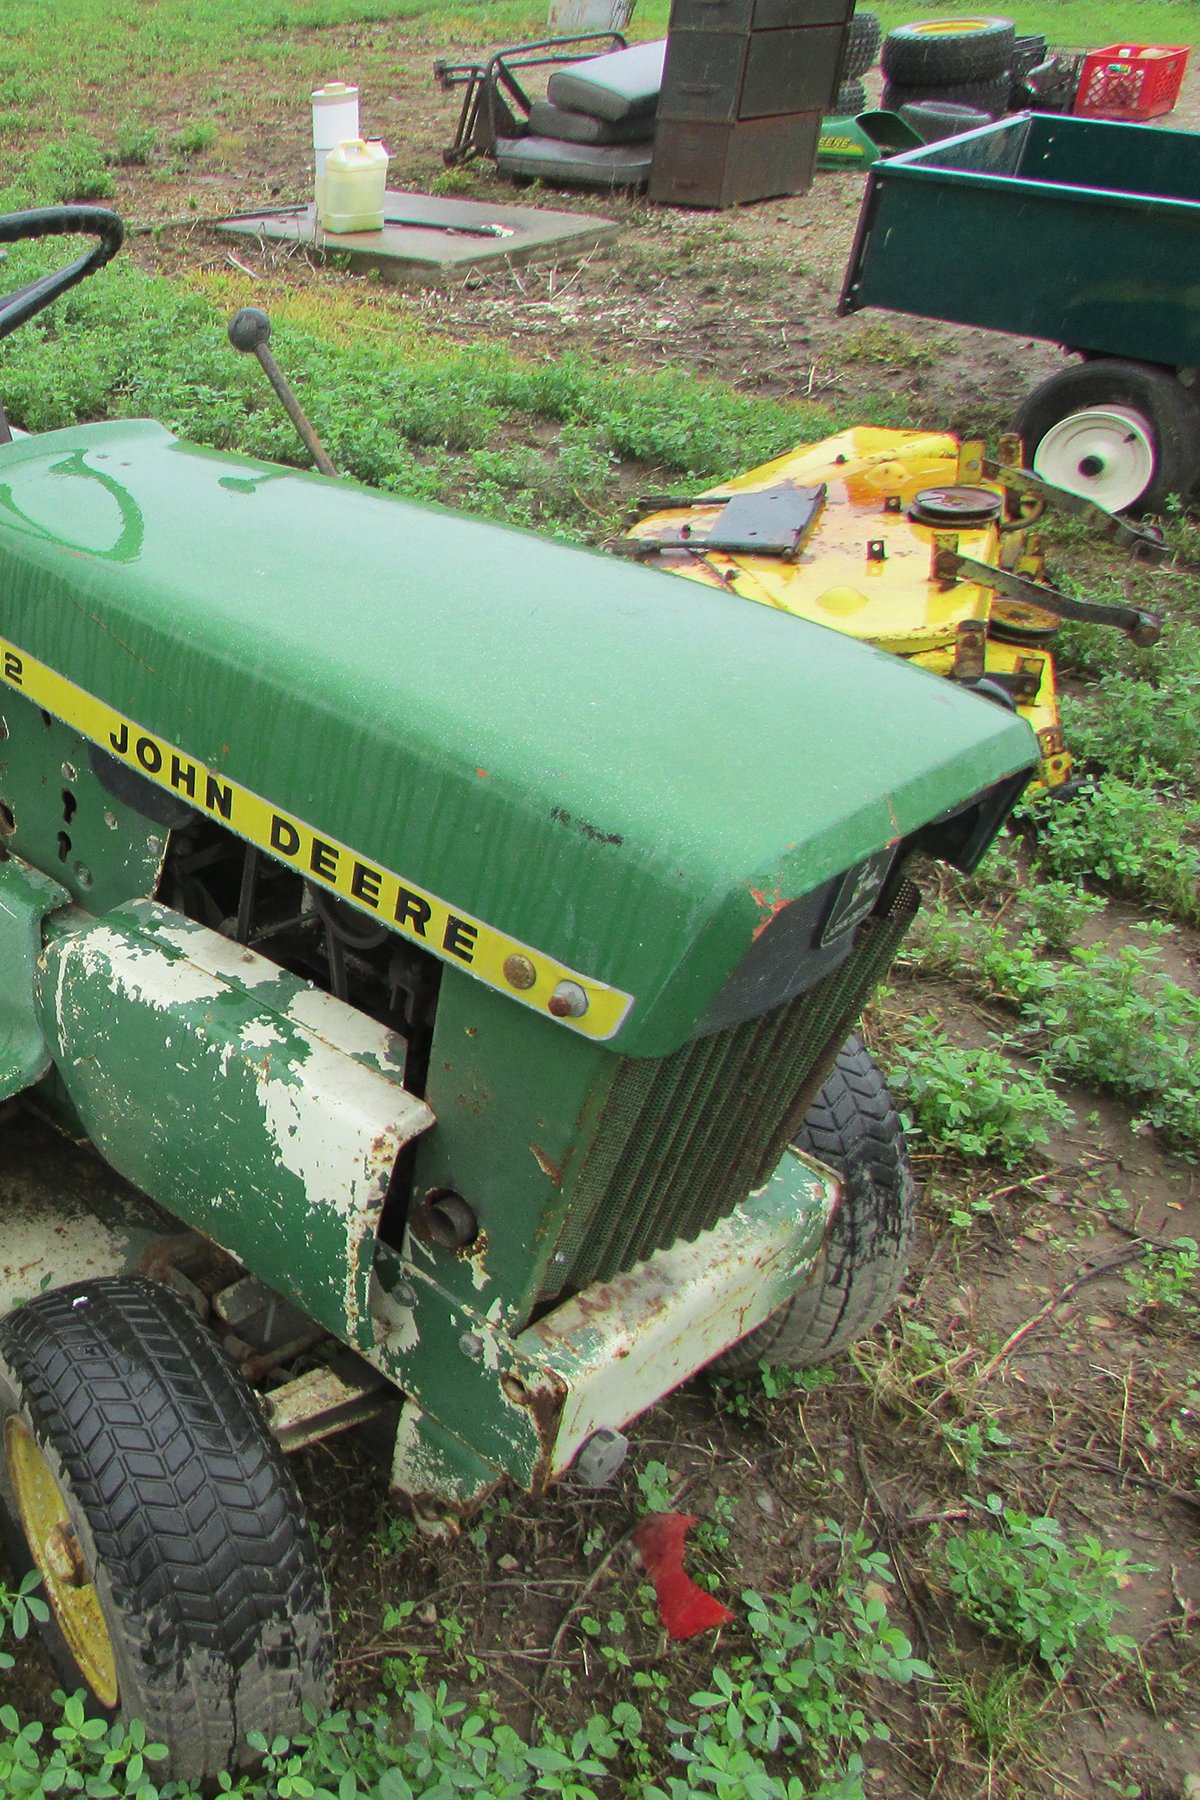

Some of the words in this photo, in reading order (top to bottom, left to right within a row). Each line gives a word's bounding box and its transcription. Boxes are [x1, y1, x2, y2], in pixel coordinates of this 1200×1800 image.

[818, 137, 851, 149] EERE
[109, 723, 234, 820] JOHN
[270, 814, 479, 964] DEERE
